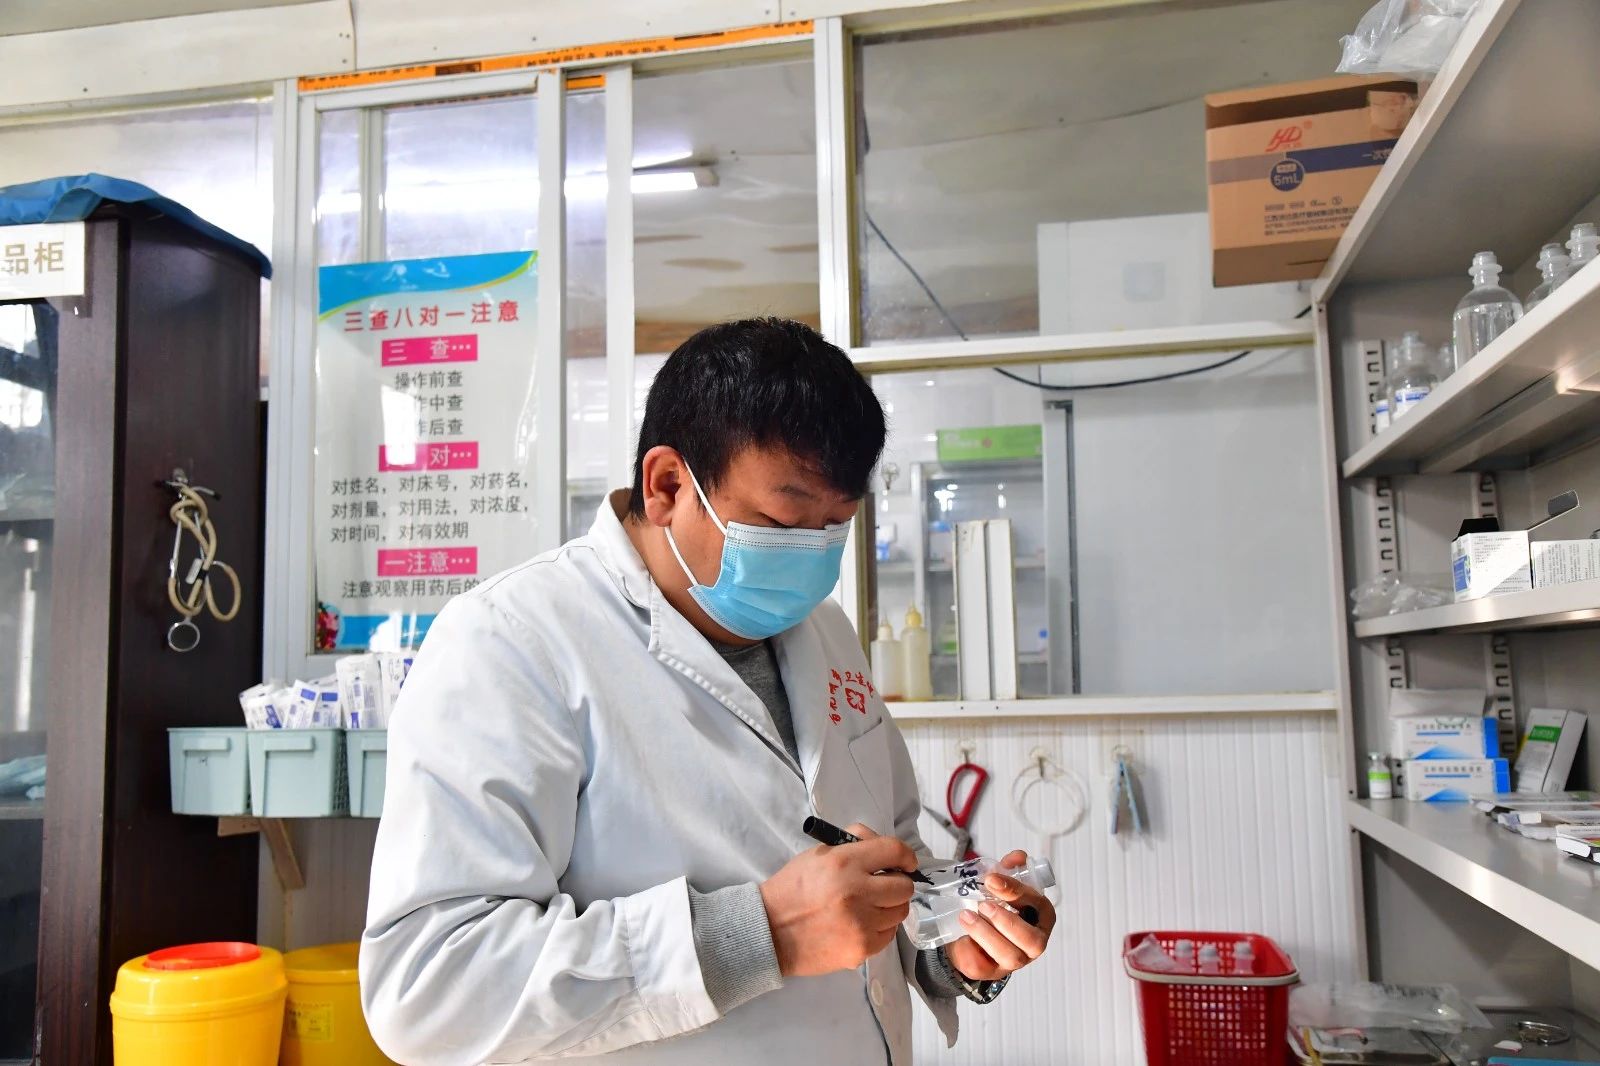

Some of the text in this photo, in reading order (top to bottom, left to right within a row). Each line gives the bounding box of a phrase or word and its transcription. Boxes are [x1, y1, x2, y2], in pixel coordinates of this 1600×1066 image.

[344, 300, 520, 332] 三查八对一注意
[395, 370, 464, 390] 操作前查
